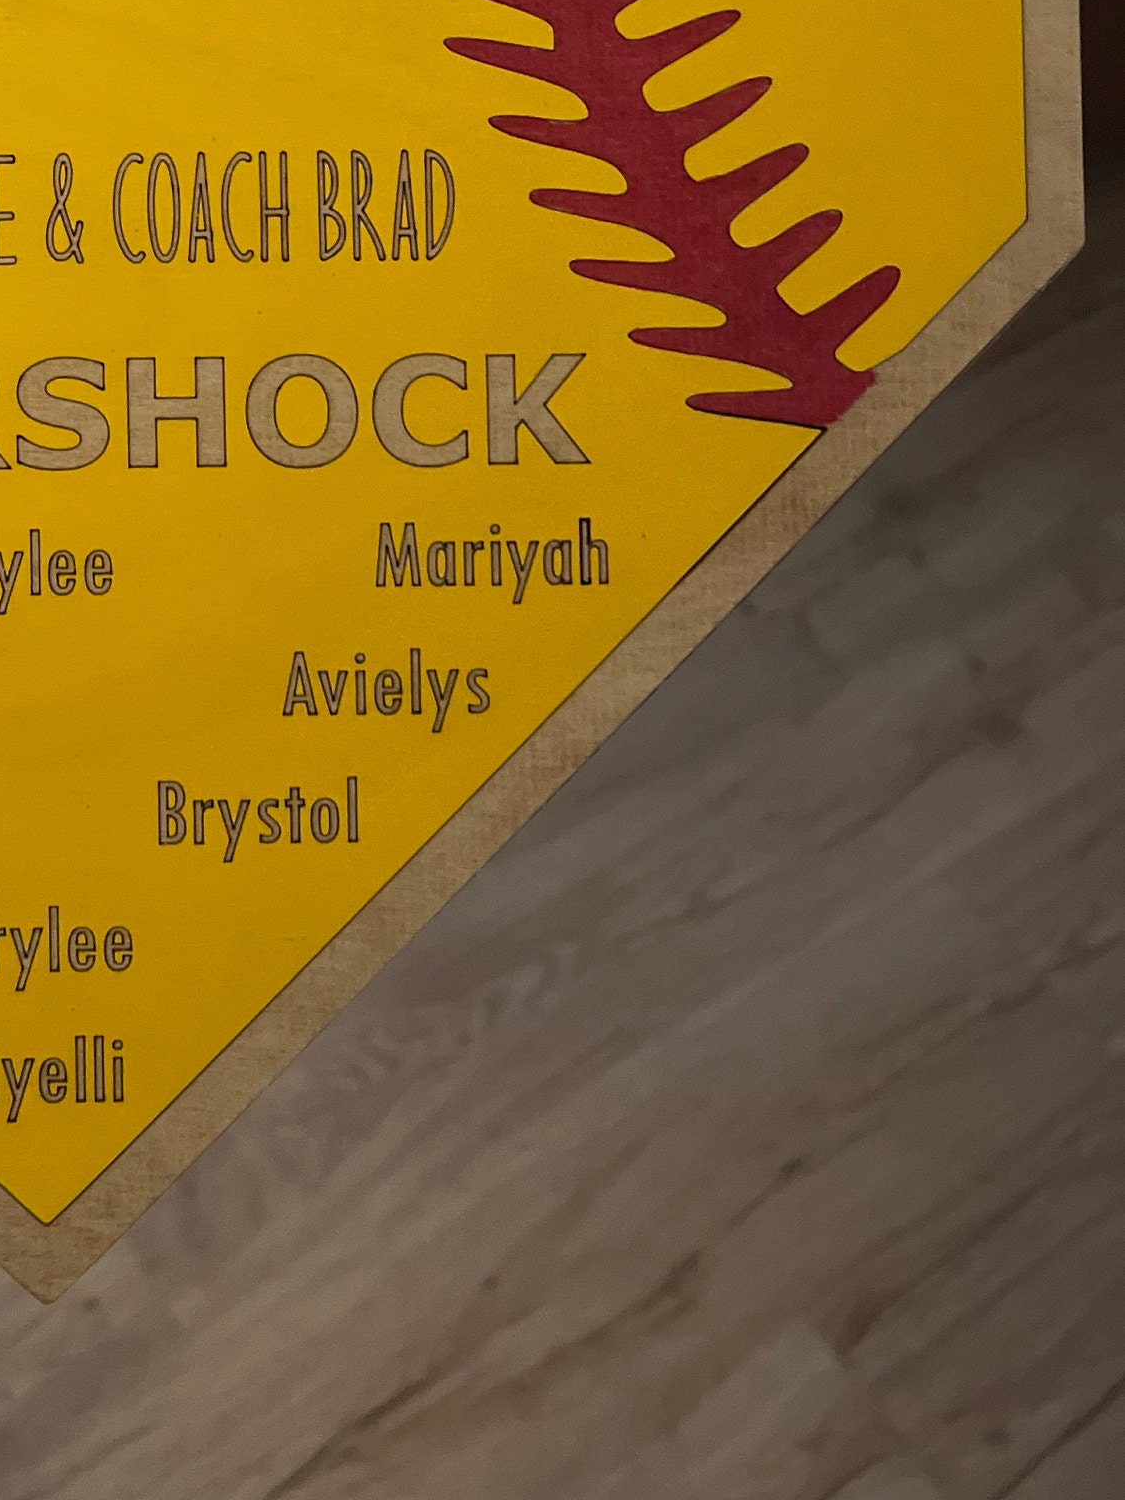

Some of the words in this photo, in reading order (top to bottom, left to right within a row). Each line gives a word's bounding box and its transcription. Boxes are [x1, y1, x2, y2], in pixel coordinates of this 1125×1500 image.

[45, 152, 84, 264] &
[113, 151, 290, 264] COACH
[317, 148, 456, 263] BRAD
[376, 517, 609, 605] Mariyah
[282, 648, 490, 733] Avielys
[157, 776, 359, 863] Brystol
